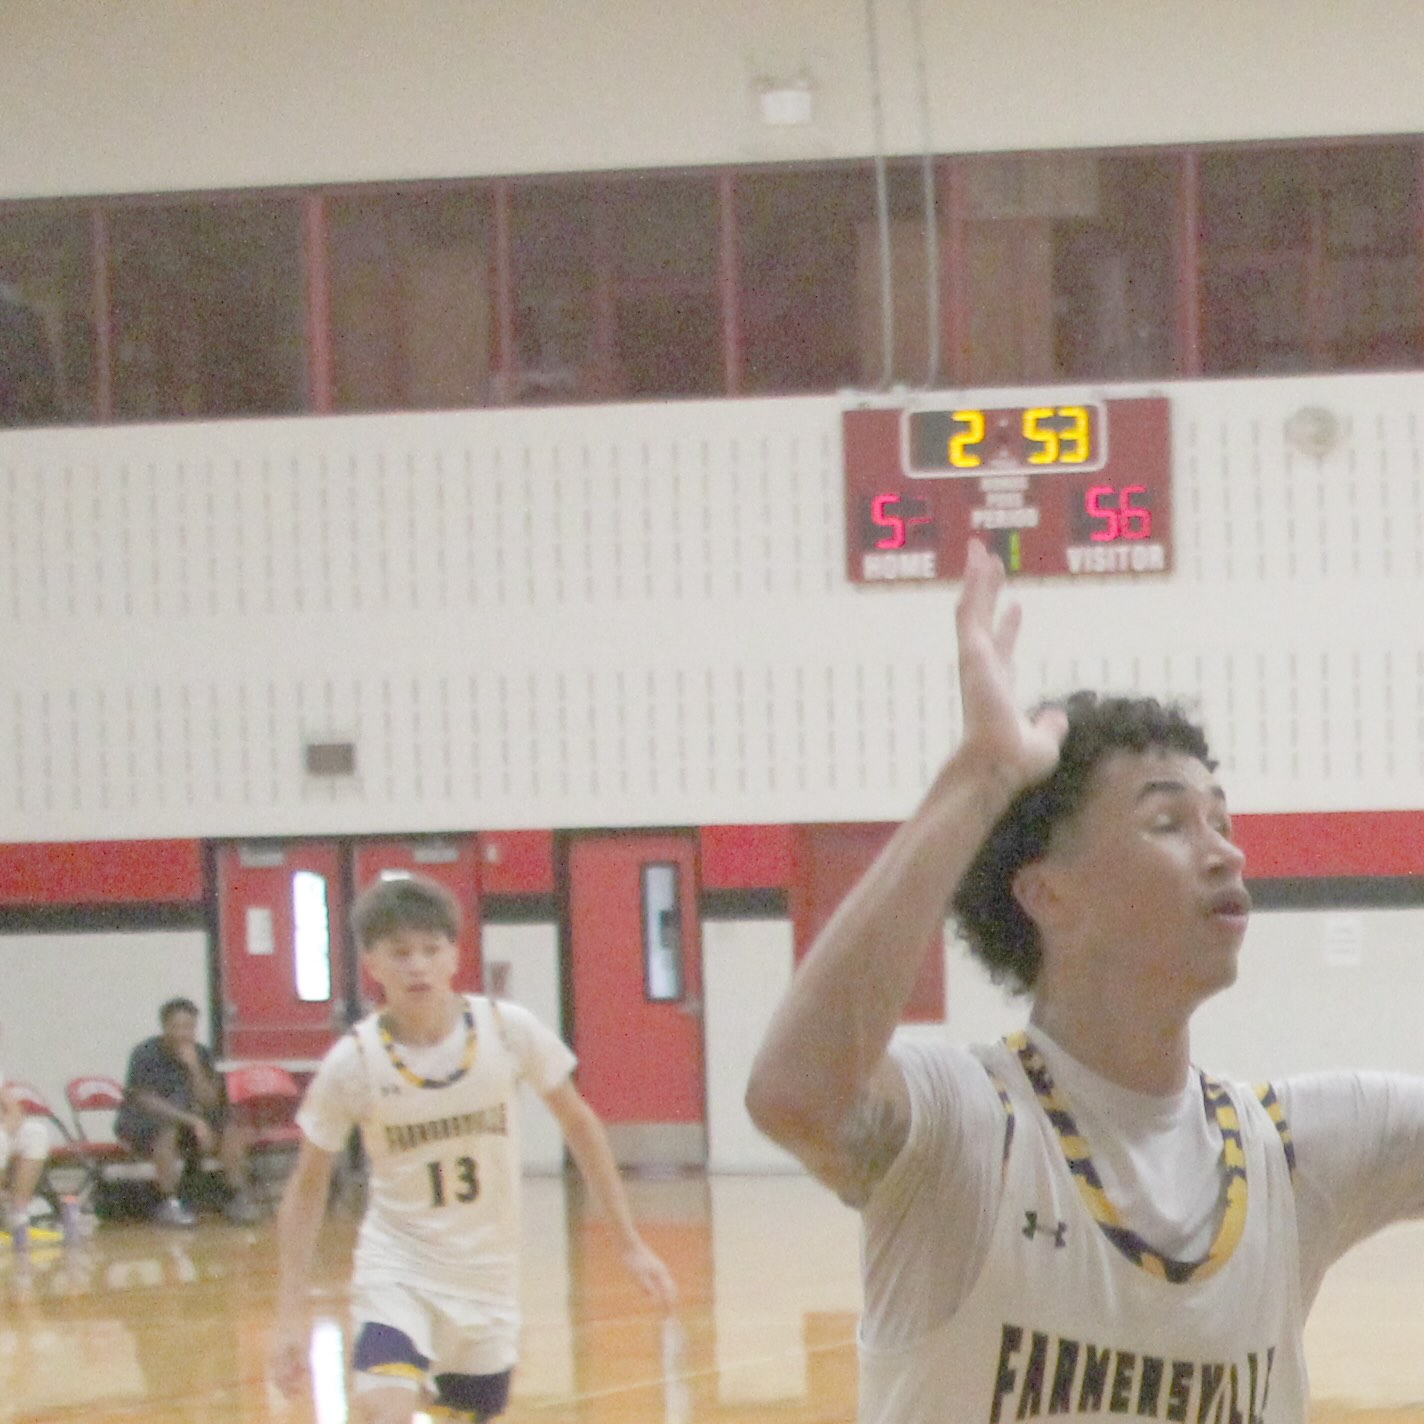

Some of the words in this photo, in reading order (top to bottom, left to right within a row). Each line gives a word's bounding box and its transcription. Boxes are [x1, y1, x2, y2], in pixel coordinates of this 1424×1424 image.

[1084, 485, 1152, 541] 56
[863, 551, 937, 580] HOME
[1066, 544, 1165, 574] VISITOR
[427, 1156, 480, 1207] 13
